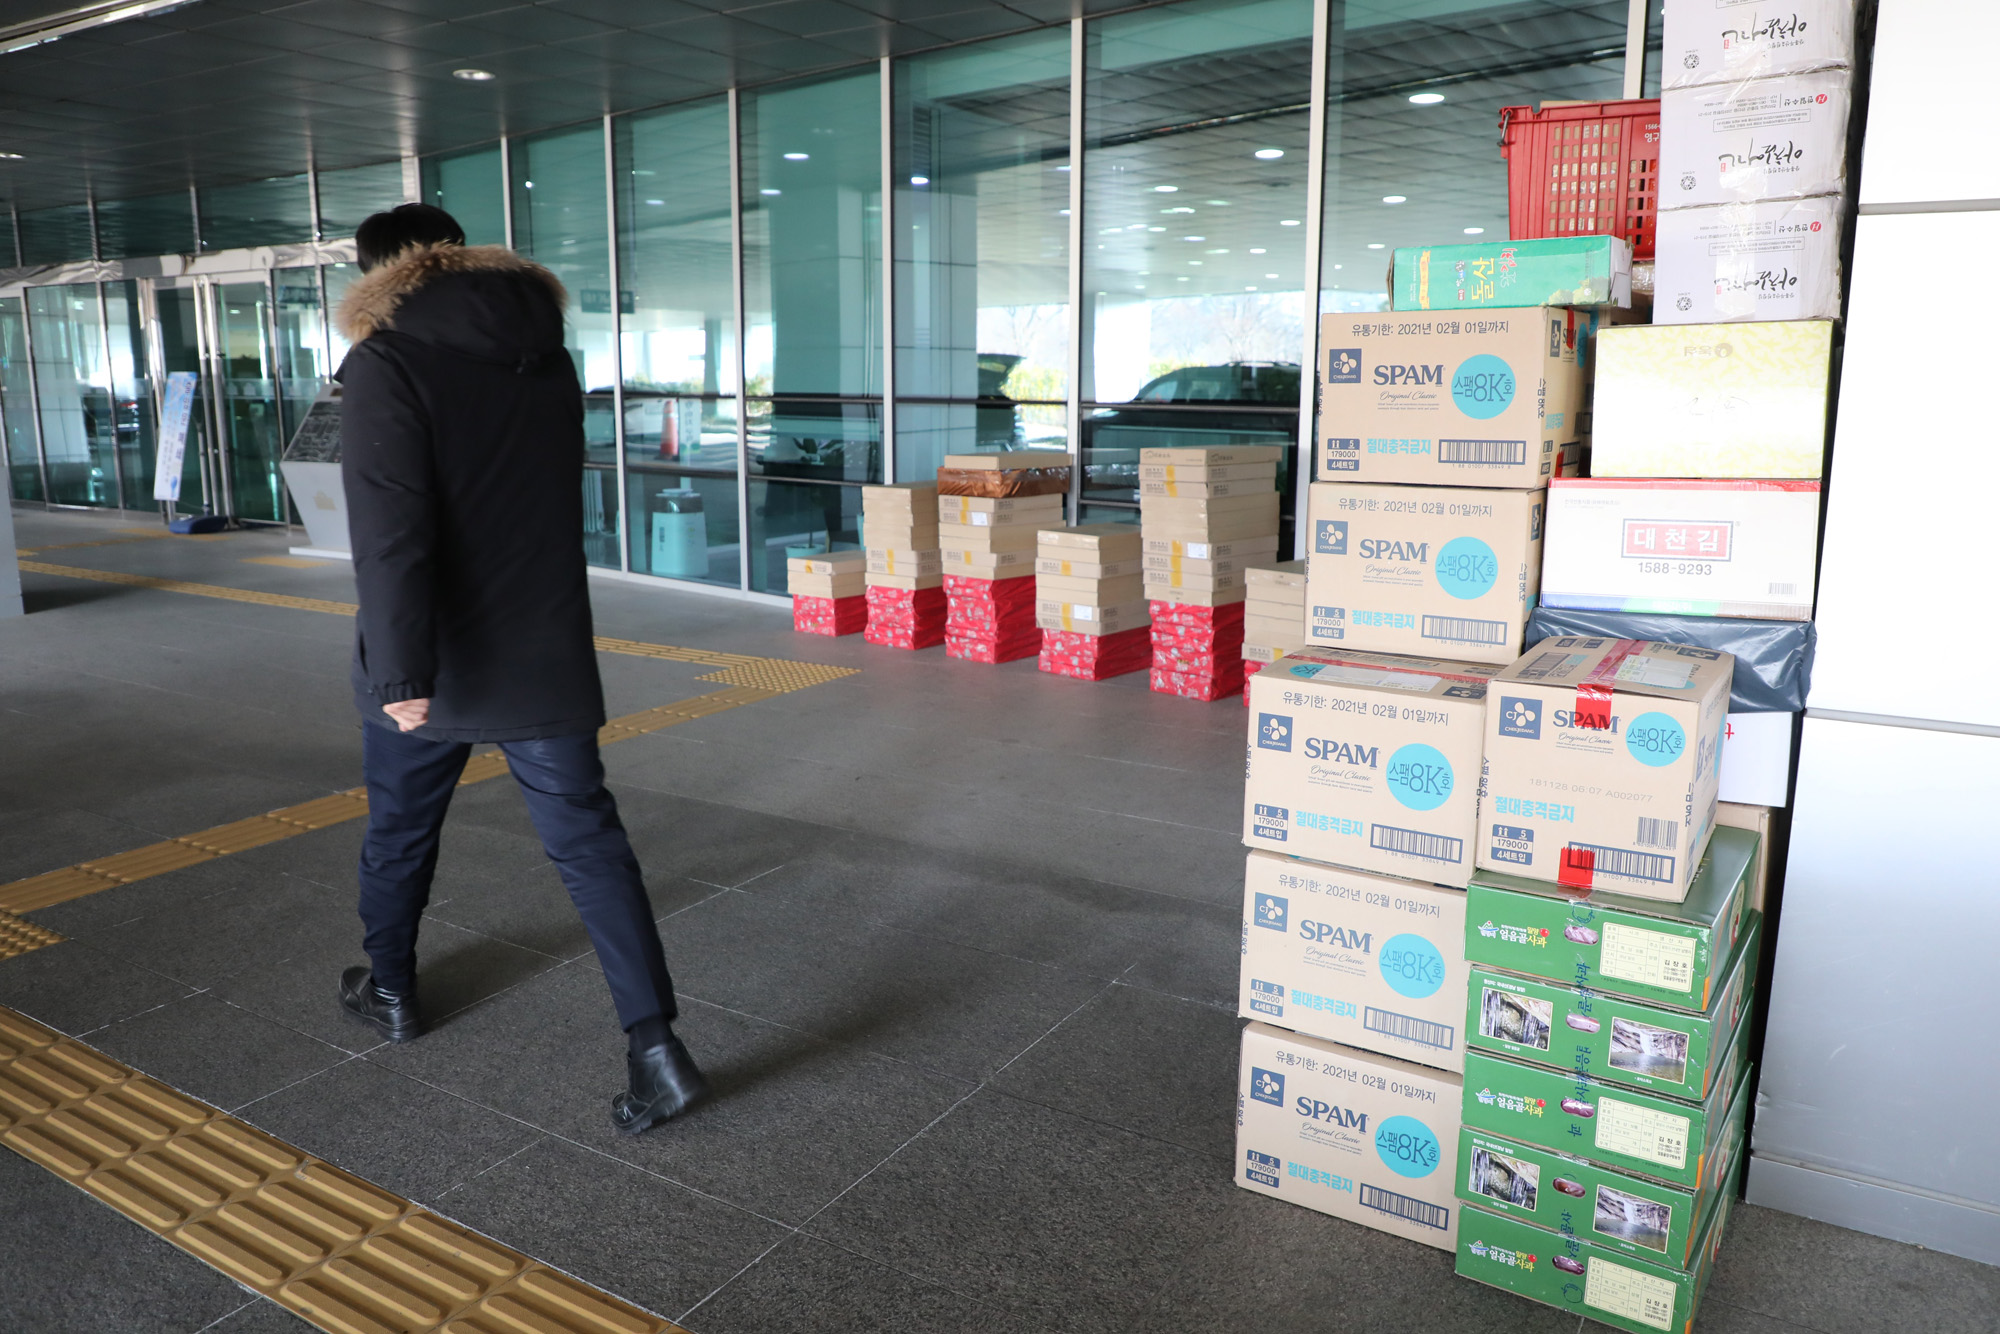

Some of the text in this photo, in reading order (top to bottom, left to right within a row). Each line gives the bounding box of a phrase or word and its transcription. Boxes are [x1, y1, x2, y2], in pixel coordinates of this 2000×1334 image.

[1352, 320, 1509, 336] 유통기한: 2021년 02월 01일까지
[1373, 365, 1443, 386] SPAM
[1367, 439, 1430, 454] 절대충격금지
[1331, 461, 1355, 470] 4세트입
[1339, 499, 1492, 517] 유통기한: 2021년 02월 01일까지
[1359, 538, 1428, 563] SPAM
[1638, 562, 1712, 576] 1588-9293
[1352, 610, 1414, 629] 절대충격금지
[1316, 628, 1340, 637] 4세트입
[1283, 692, 1449, 725] 유통기한: 2021년 02월 01일까지
[1553, 710, 1618, 733] SPAM
[1304, 738, 1379, 768] SPAM
[1495, 796, 1574, 822] 절대충격금지
[1258, 817, 1284, 827] 179000
[1296, 811, 1363, 837] 절대충격금지
[1258, 827, 1282, 838] 4세트입
[1497, 838, 1528, 850] 179000
[1497, 851, 1526, 863] 4세트입
[1279, 874, 1440, 918] 유통기한: 2021년 02월 01일까지
[1300, 920, 1372, 954] SPAM
[1255, 992, 1280, 1004] 179000
[1291, 989, 1357, 1019] 절대충격금지
[1255, 1002, 1278, 1014] 4세트입
[1276, 1051, 1436, 1103] 유통기한: 2021년 02월 01일까지
[1296, 1097, 1368, 1134] SPAM
[1251, 1162, 1275, 1175] 179000
[1288, 1161, 1352, 1193] 절대충격금지
[1250, 1173, 1274, 1185] 4세트입
